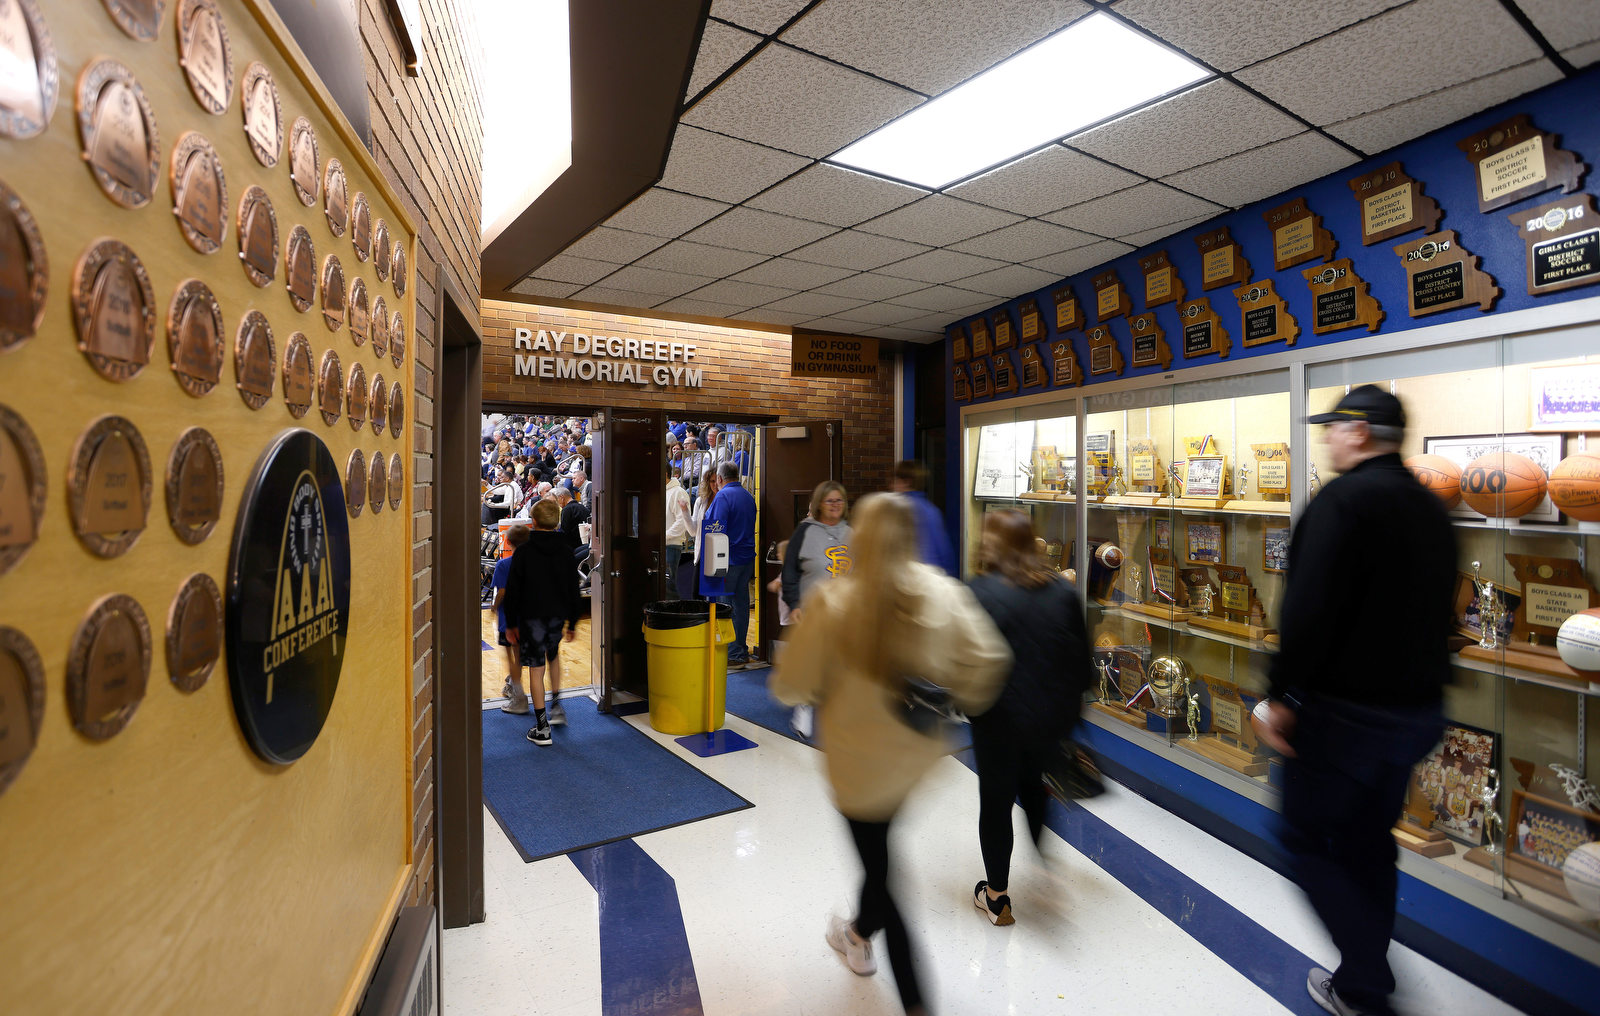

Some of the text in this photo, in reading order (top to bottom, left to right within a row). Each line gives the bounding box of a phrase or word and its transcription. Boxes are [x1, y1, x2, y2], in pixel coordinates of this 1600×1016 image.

[1486, 157, 1504, 169] BOYS
[1505, 146, 1530, 160] CLASS
[1495, 157, 1528, 175] DISTRICT
[1497, 165, 1528, 181] SOCCER
[1491, 172, 1536, 194] FIRST PLACE
[1369, 198, 1384, 208] BOYS
[1384, 192, 1402, 202] CLASS
[1375, 200, 1400, 213] DISTRICT
[1370, 204, 1406, 221] BASKETBALL
[1372, 212, 1406, 229] FIRST PLACE
[1285, 226, 1300, 234] CLASS
[1282, 242, 1309, 256] FIRST PLACE
[1538, 244, 1562, 256] GIRLS
[1563, 236, 1589, 249] CLASS
[1548, 248, 1585, 263] DISTRICT
[1550, 255, 1583, 268] SOCCER
[1418, 274, 1433, 282] BOYS
[1434, 268, 1454, 279] CLASS
[1543, 263, 1592, 280] FIRST PLACE
[1416, 280, 1462, 296] CROSS COUNTRY
[1425, 278, 1450, 288] DISTRICT
[1320, 296, 1334, 304] GIRLS
[1334, 292, 1350, 300] CLASS
[1422, 290, 1456, 304] FIRST PLACE
[1326, 300, 1346, 310] DISTRICT
[1332, 304, 1354, 312] COUNTRY
[1336, 312, 1350, 320] PLACE
[515, 328, 697, 364] RAY DEGREEFF
[810, 340, 862, 350] NO FOOD
[808, 352, 862, 362] OR DRINK
[515, 354, 702, 388] MEMORIAL GYM
[794, 362, 876, 374] IN GYMNASIUM
[1461, 468, 1507, 494] 600
[294, 484, 316, 513] BODY
[278, 557, 330, 636] AAA
[1550, 590, 1572, 598] CLASS
[1536, 614, 1553, 622] FIRST
[264, 608, 339, 674] CONFERENCE
